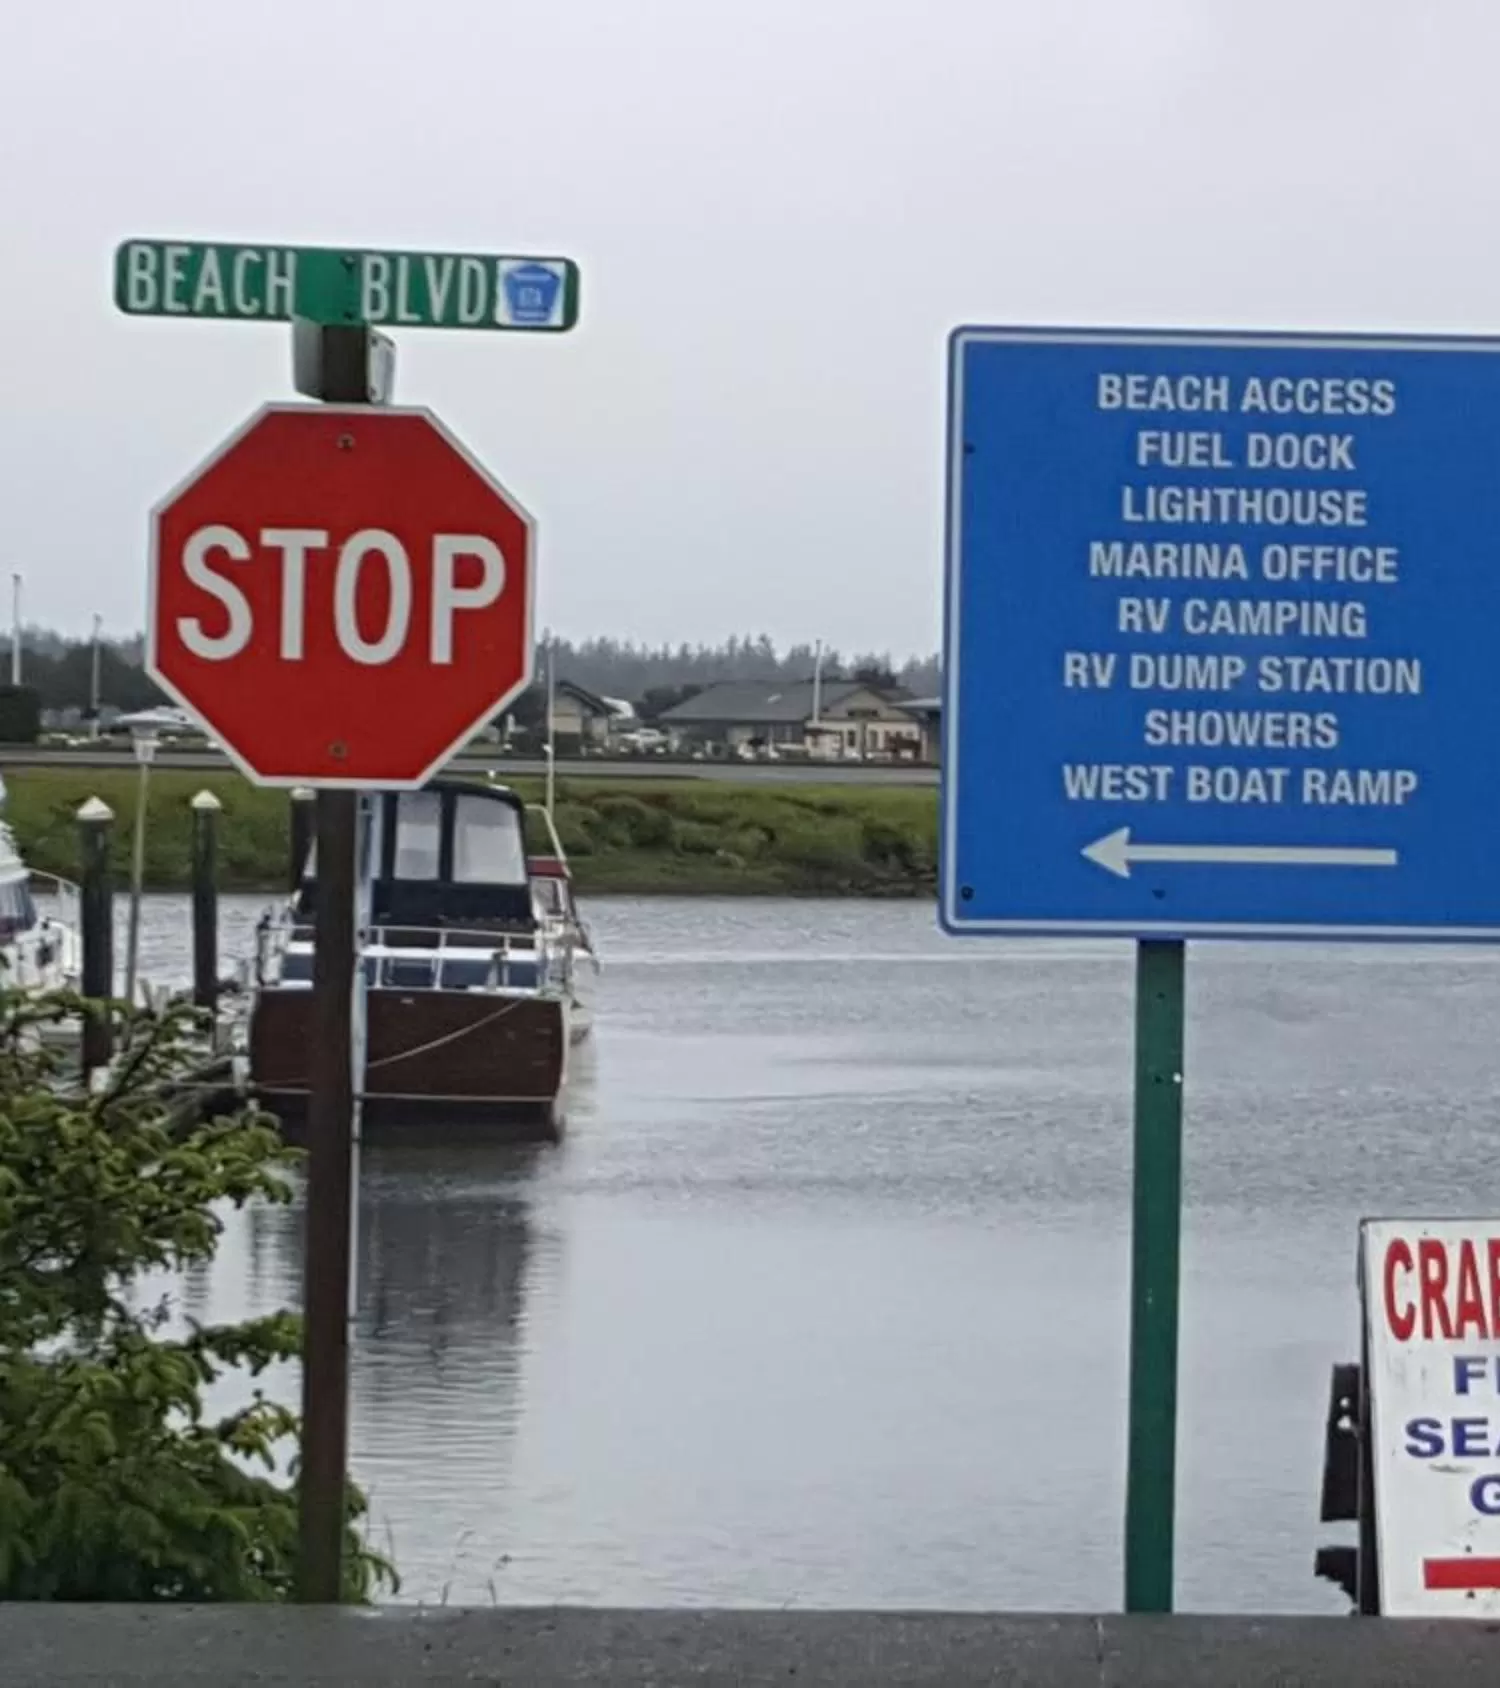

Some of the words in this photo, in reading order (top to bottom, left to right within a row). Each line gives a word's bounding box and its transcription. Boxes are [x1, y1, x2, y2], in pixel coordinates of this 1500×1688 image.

[126, 244, 297, 315] BEACH
[361, 254, 488, 325] BLVD
[1098, 373, 1229, 411] BEACH
[1240, 377, 1397, 415] ACCESS
[1137, 431, 1233, 467] FUEL
[1247, 433, 1356, 470] DOCK
[1121, 486, 1368, 527] LIGHTHOUSE
[1089, 542, 1248, 579] MARINA
[1261, 546, 1399, 584] OFFICE
[176, 524, 506, 665] STOP
[1118, 597, 1171, 633] RV
[1183, 598, 1368, 639] CAMPING
[1063, 652, 1116, 689] RV
[1129, 654, 1246, 692] DUMP
[1257, 656, 1421, 694] STATION
[1143, 711, 1340, 749] SHOWERS
[1063, 765, 1173, 801] WEST
[1186, 766, 1290, 803] BOAT
[1302, 769, 1419, 806] RAMP
